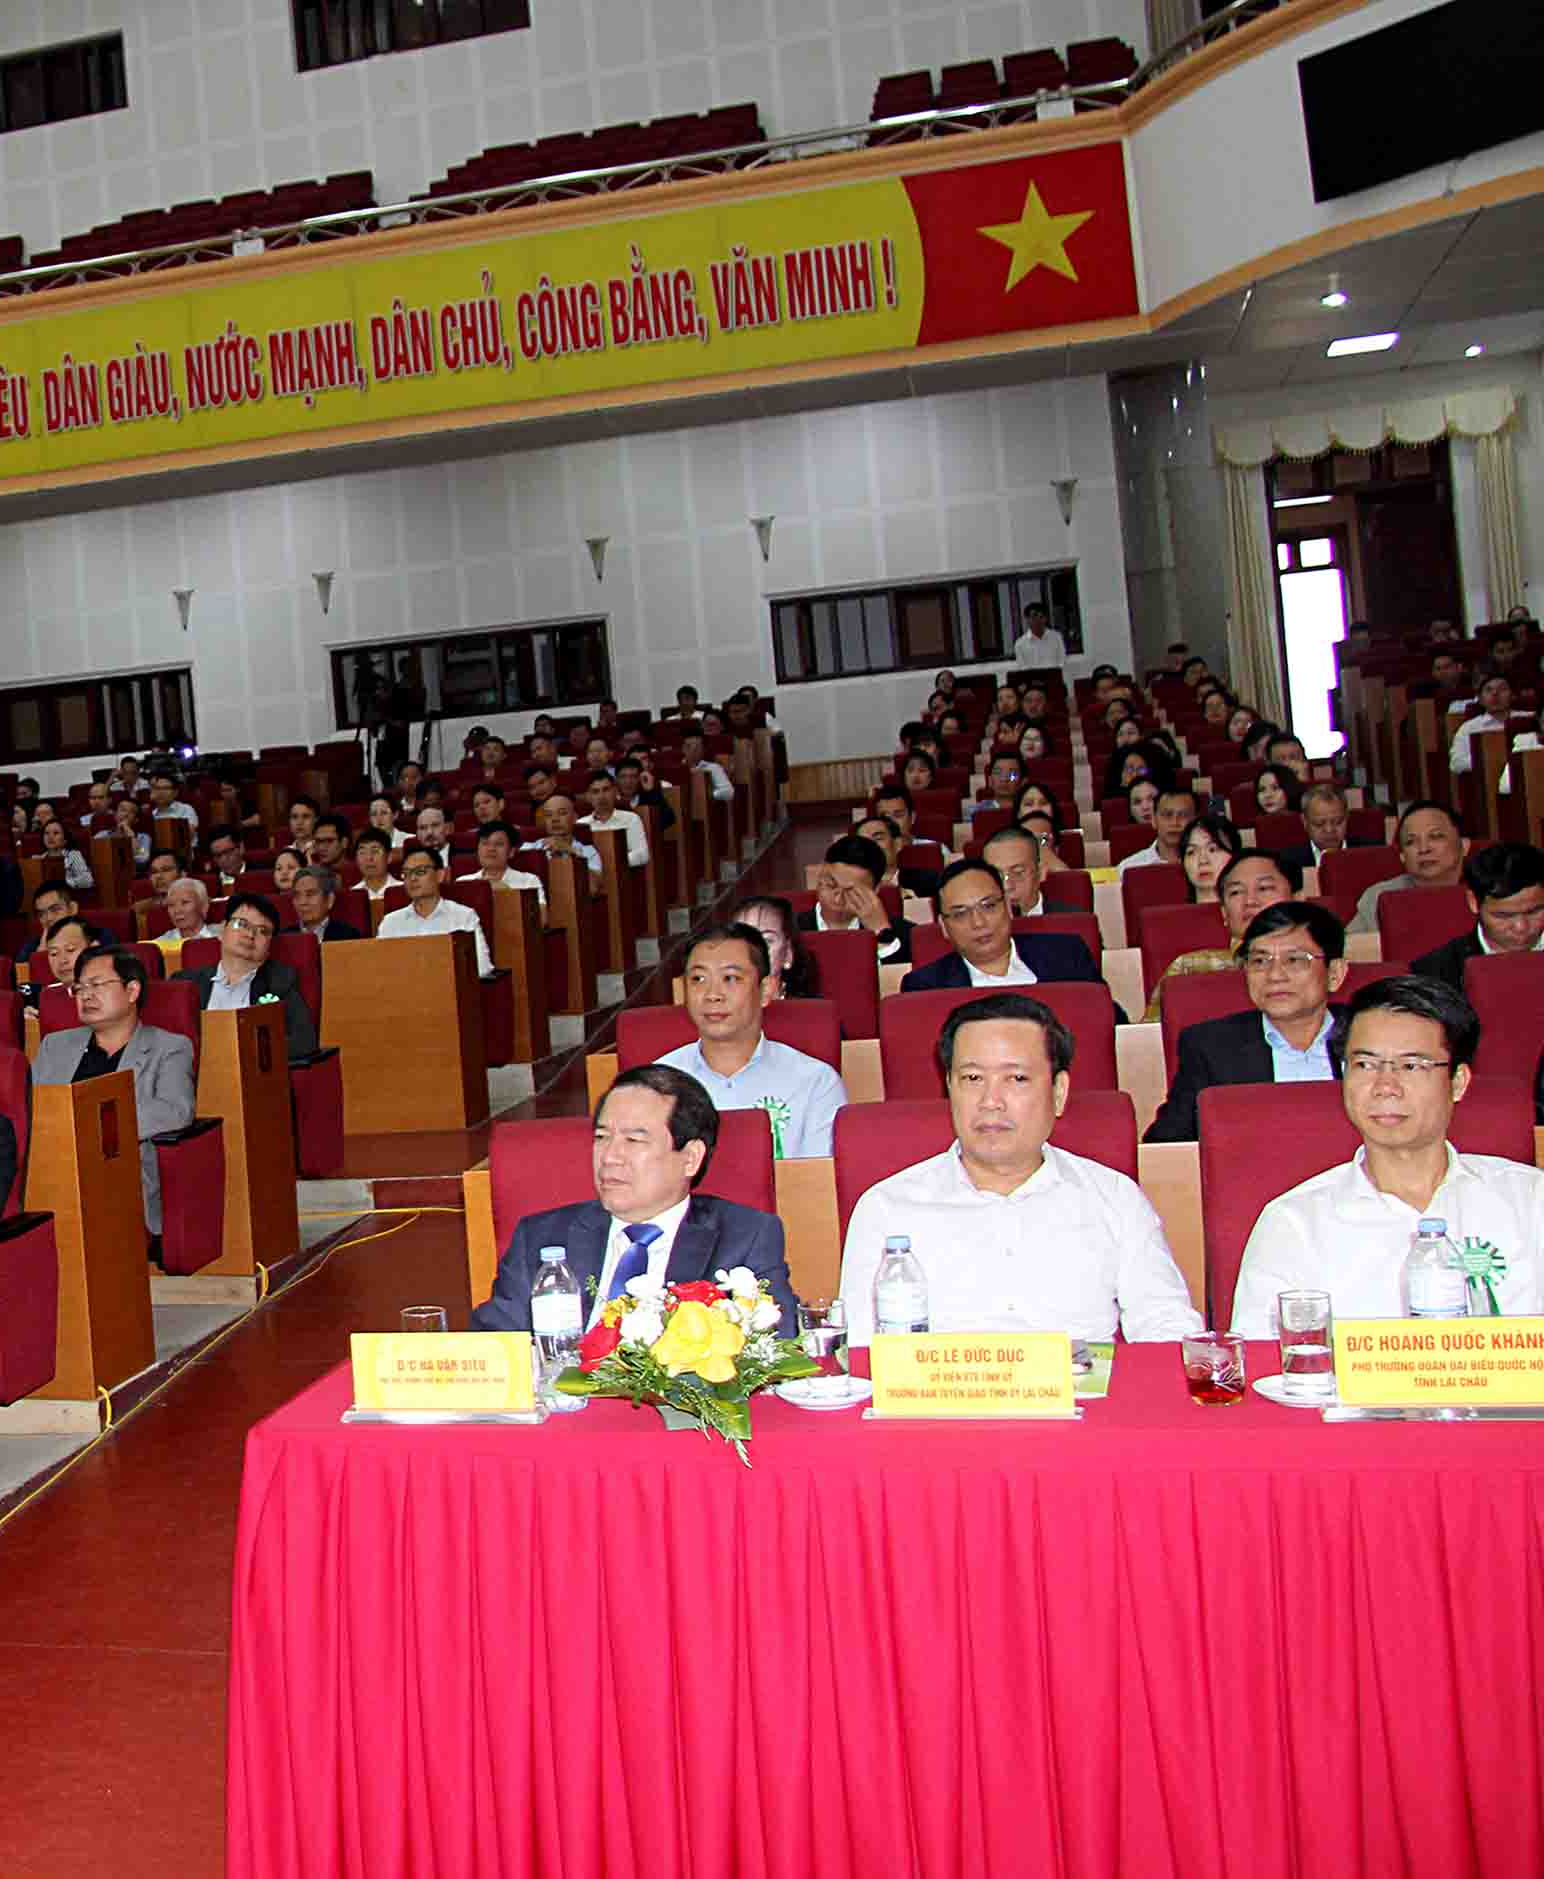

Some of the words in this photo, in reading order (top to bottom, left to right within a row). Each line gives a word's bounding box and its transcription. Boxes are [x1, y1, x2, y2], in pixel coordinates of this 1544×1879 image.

[42, 353, 101, 432] DÂN
[106, 340, 182, 423] GIÀU,
[184, 320, 263, 411] NƯỚC
[268, 320, 367, 408] MẠNH,
[370, 299, 434, 382] DÂN
[439, 269, 514, 372] CHỦ,
[516, 274, 603, 360] CÔNG
[608, 243, 708, 346] BẰNG,
[710, 245, 779, 331] VĂN
[783, 238, 876, 321] MINH
[1347, 1335, 1373, 1352] Đ/C
